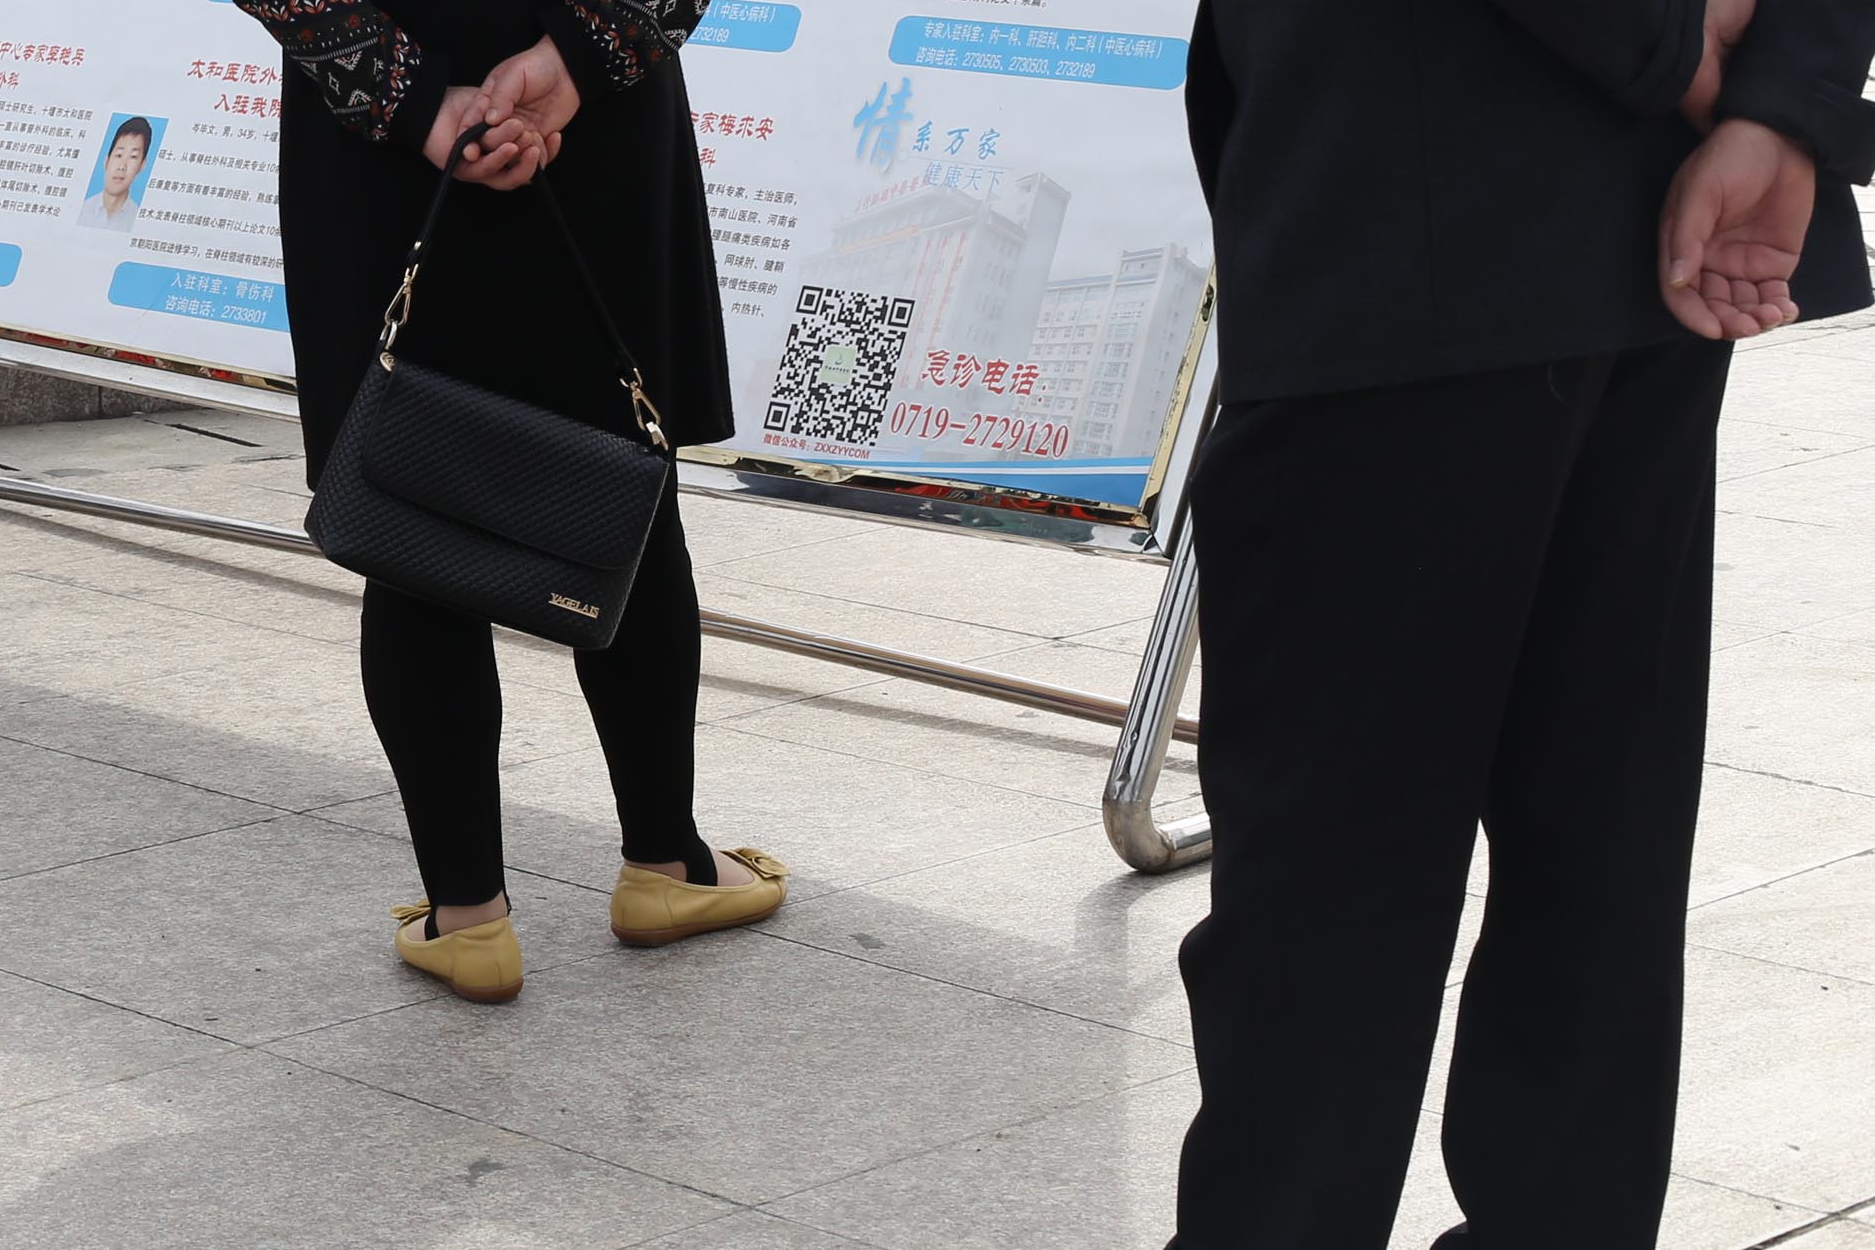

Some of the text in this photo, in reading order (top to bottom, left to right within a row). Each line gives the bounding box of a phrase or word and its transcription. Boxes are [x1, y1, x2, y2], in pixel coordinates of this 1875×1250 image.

[187, 59, 283, 86] 太和医院外
[925, 161, 1005, 193] 健康天下
[890, 401, 1070, 459] 0719-2729120
